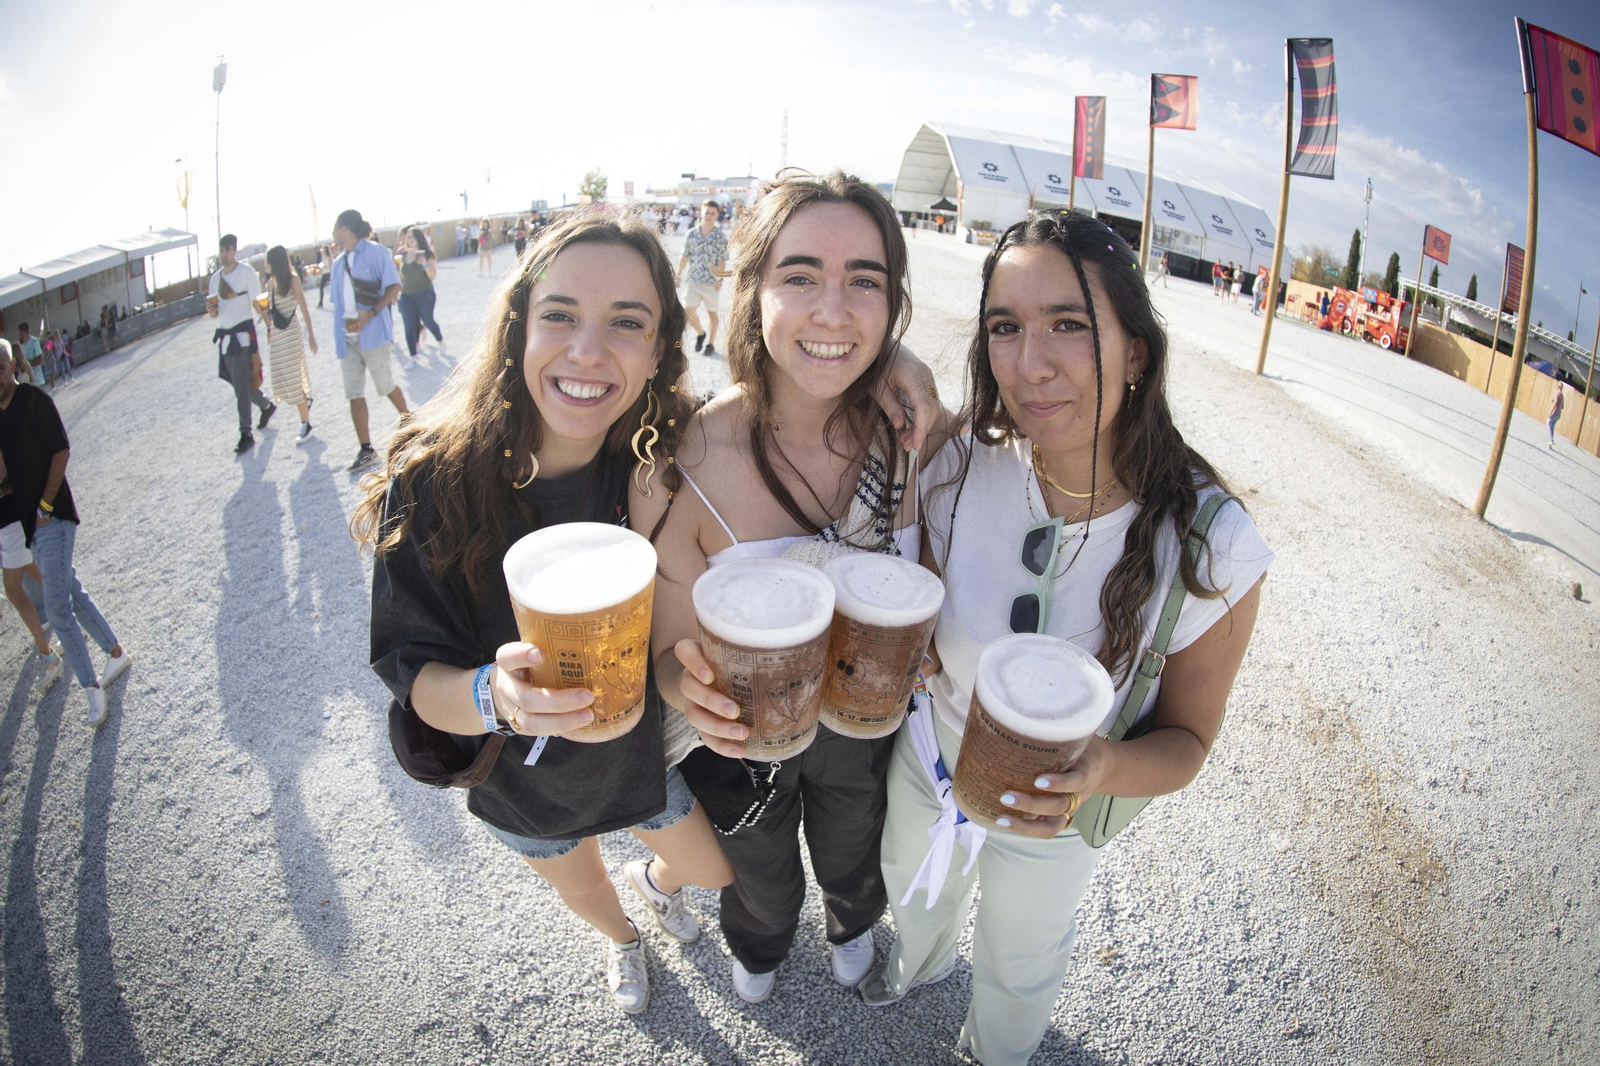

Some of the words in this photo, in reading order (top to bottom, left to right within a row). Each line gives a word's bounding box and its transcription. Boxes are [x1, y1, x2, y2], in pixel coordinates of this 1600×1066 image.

[559, 661, 582, 669] MIRA
[732, 682, 752, 692] MIRA
[980, 712, 1020, 746] GRANADA
[1022, 743, 1060, 754] SOUND
